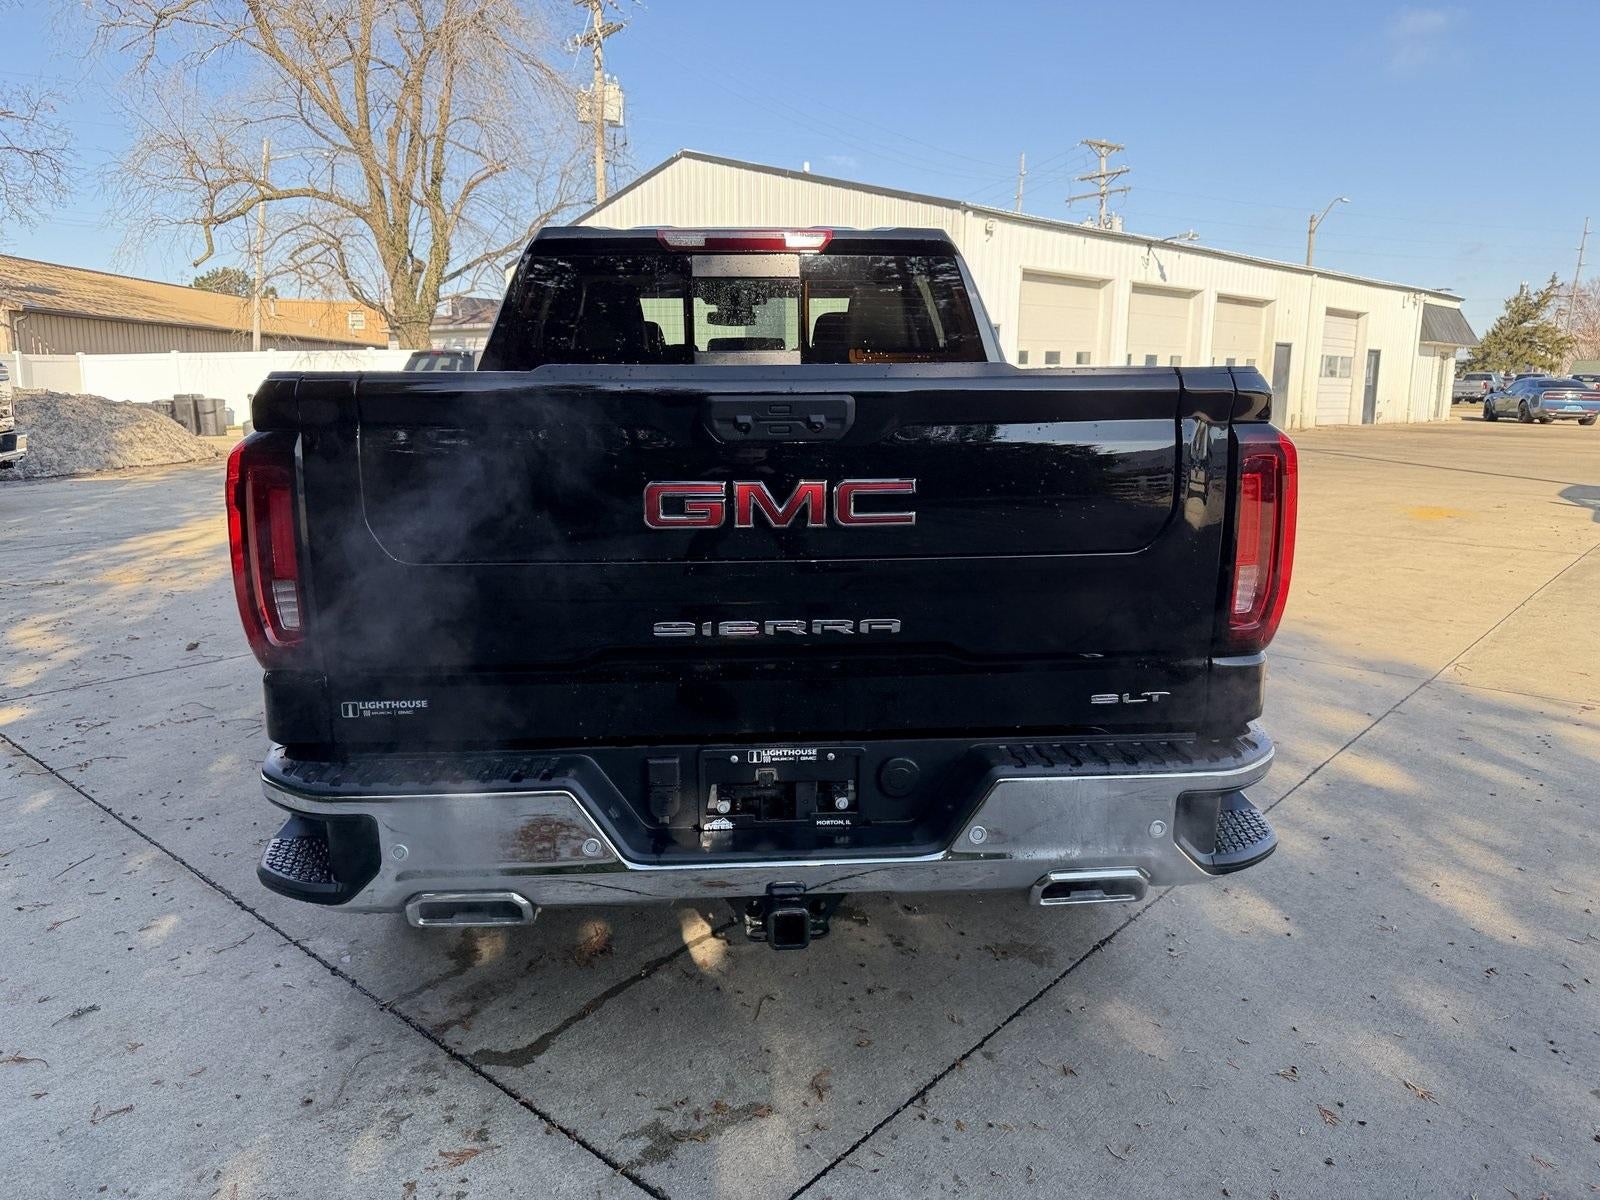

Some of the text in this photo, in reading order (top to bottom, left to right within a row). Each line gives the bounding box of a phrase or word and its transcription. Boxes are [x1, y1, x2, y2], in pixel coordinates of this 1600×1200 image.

[643, 478, 917, 530] GMC
[653, 619, 901, 637] SIERRA
[1090, 691, 1171, 704] SLT
[359, 700, 428, 710] LIGHTHOUSE
[762, 748, 817, 756] LIGHTHOUSE
